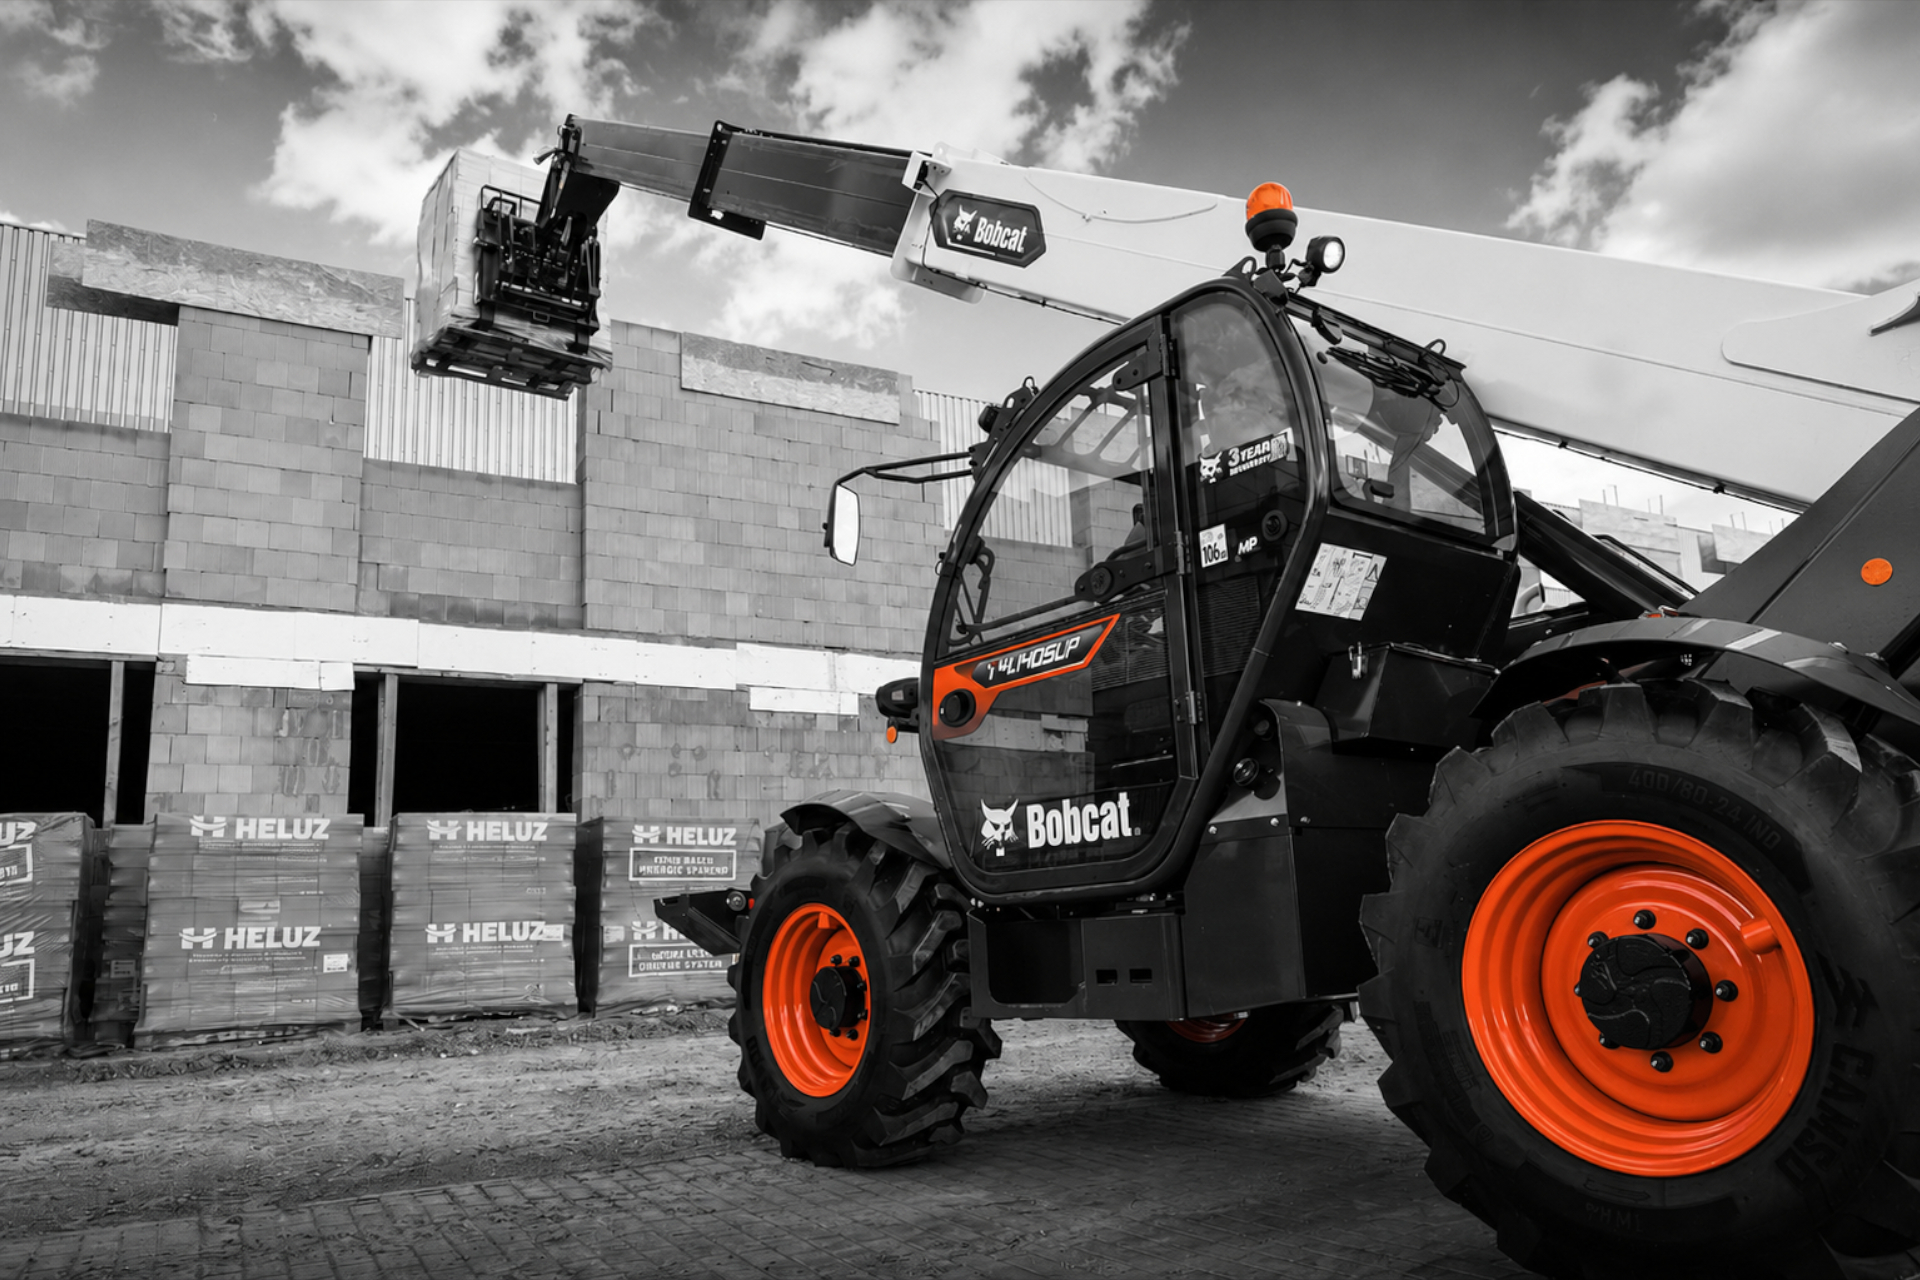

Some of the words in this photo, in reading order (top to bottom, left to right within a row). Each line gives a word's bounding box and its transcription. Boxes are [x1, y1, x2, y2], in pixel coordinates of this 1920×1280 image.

[973, 216, 1028, 253] Bobcat
[1240, 440, 1271, 461] YEAR
[1202, 542, 1221, 564] 106
[235, 817, 331, 840] HELUZ
[466, 820, 548, 842] HELUZ
[1026, 791, 1133, 849] Bobcat
[666, 826, 737, 846] HELUZ
[223, 925, 322, 950] HELUZ
[462, 920, 546, 943] HELUZ
